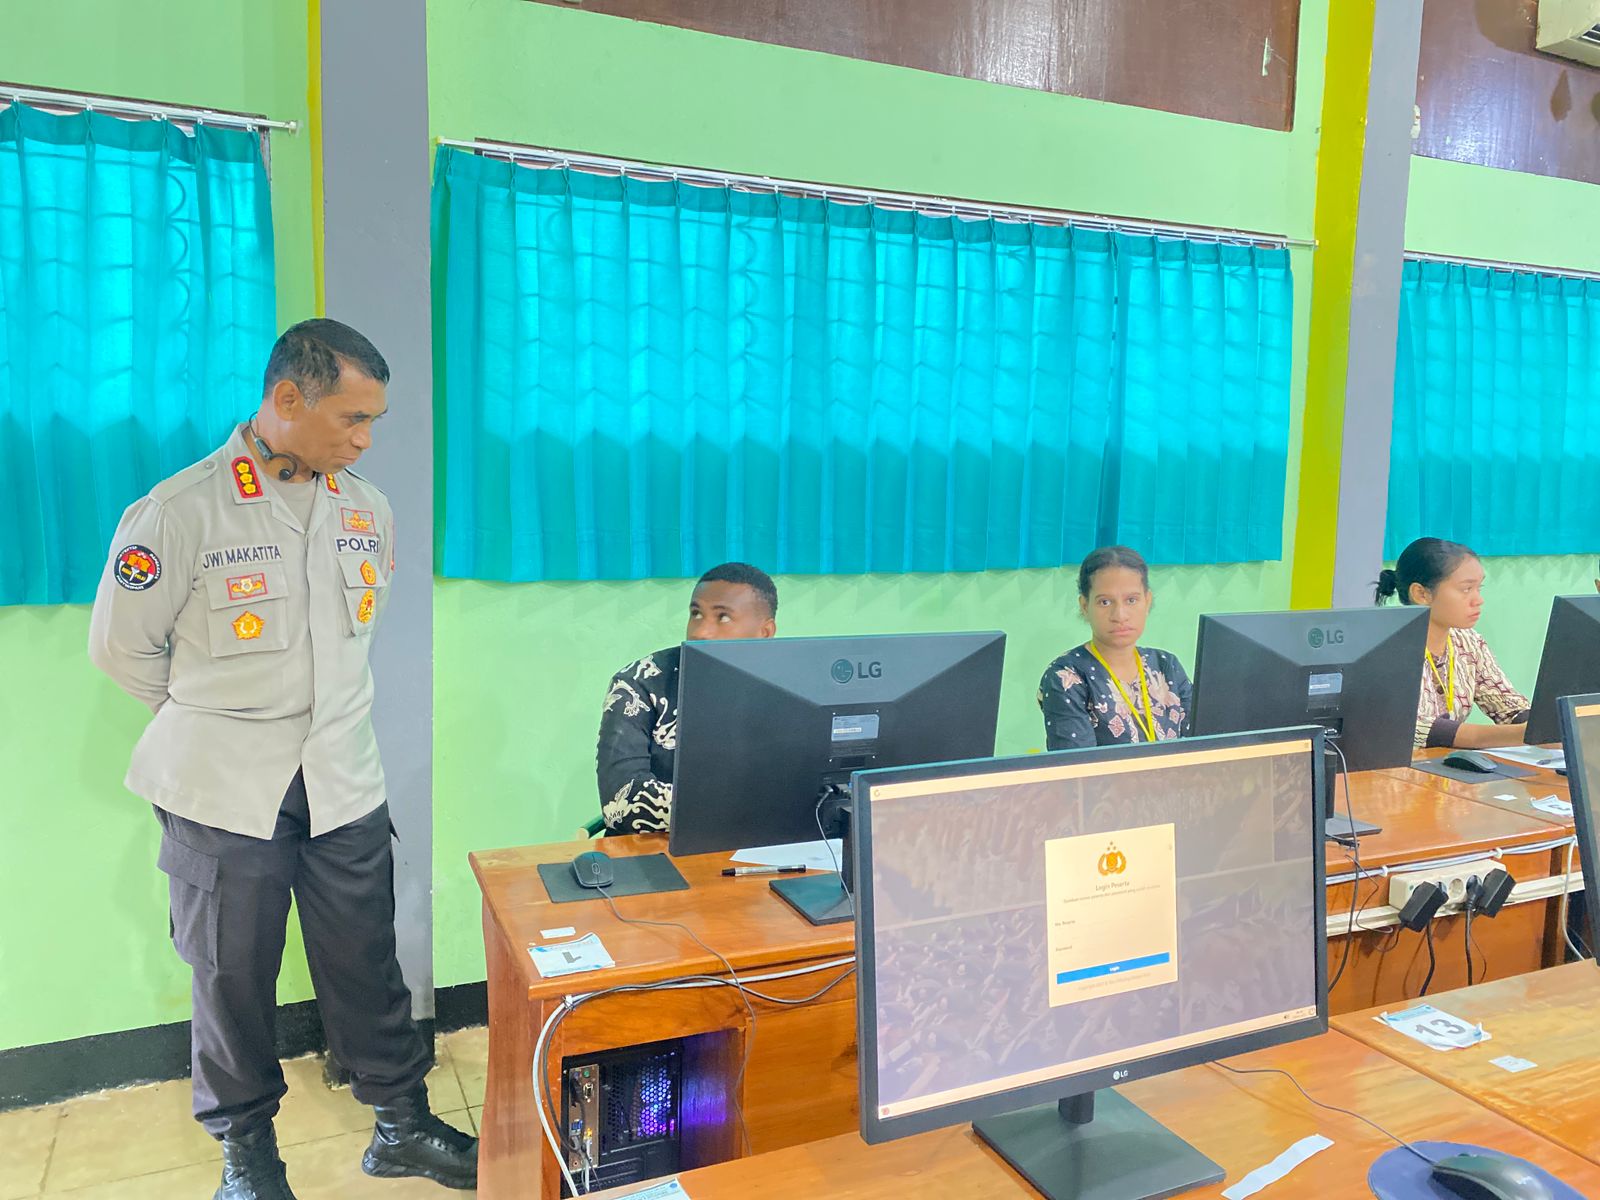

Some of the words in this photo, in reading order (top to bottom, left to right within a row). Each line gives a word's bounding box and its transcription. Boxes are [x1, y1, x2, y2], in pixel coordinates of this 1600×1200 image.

[336, 538, 379, 553] POLRI
[203, 551, 224, 569] JWI
[225, 545, 282, 564] MAKATITA
[1326, 629, 1344, 644] LG
[858, 661, 882, 679] LG
[1415, 1019, 1466, 1037] 13
[1120, 1070, 1129, 1078] LG
